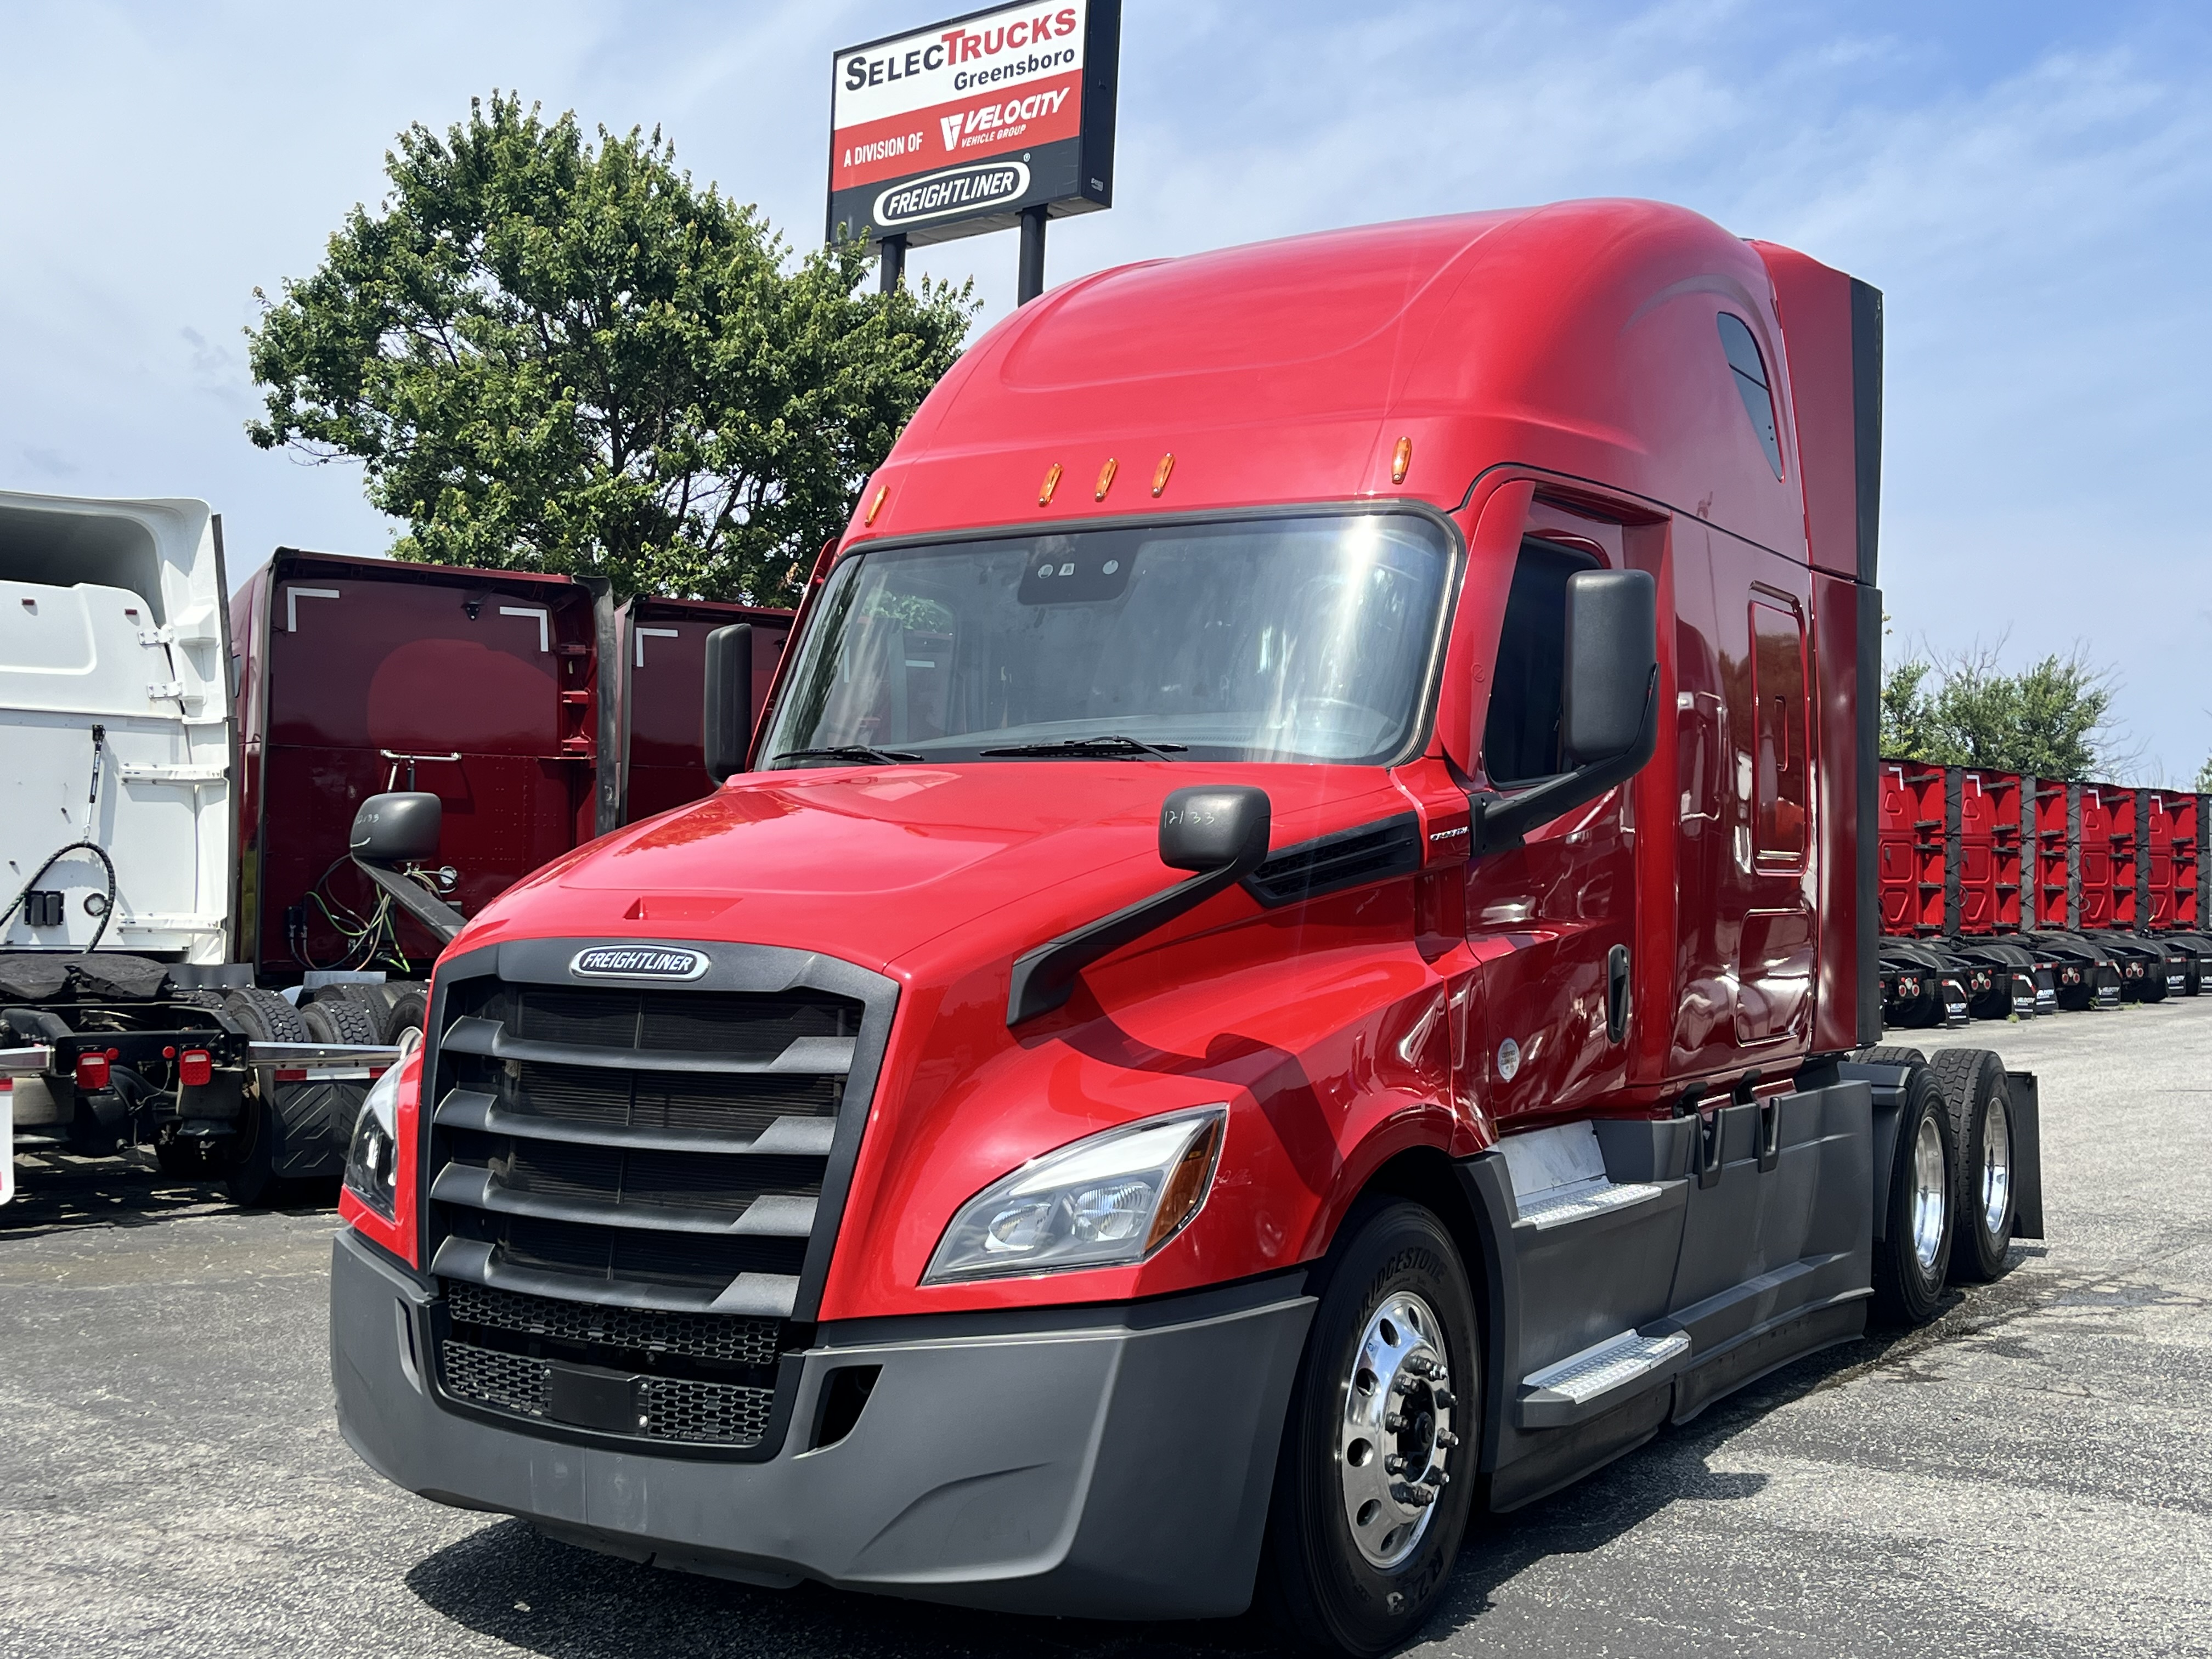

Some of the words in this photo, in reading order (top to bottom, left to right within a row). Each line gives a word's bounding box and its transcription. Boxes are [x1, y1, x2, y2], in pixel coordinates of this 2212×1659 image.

[953, 48, 1075, 91] Greensboro
[964, 87, 1070, 133] VELOCITY
[843, 149, 852, 167] A
[854, 136, 905, 166] DIVISION
[907, 132, 924, 153] OF
[961, 130, 995, 148] VEHICLE
[997, 123, 1026, 140] GROUP
[887, 171, 1014, 217] FREIGHTLINER
[582, 951, 694, 972] FREIGHTLINER
